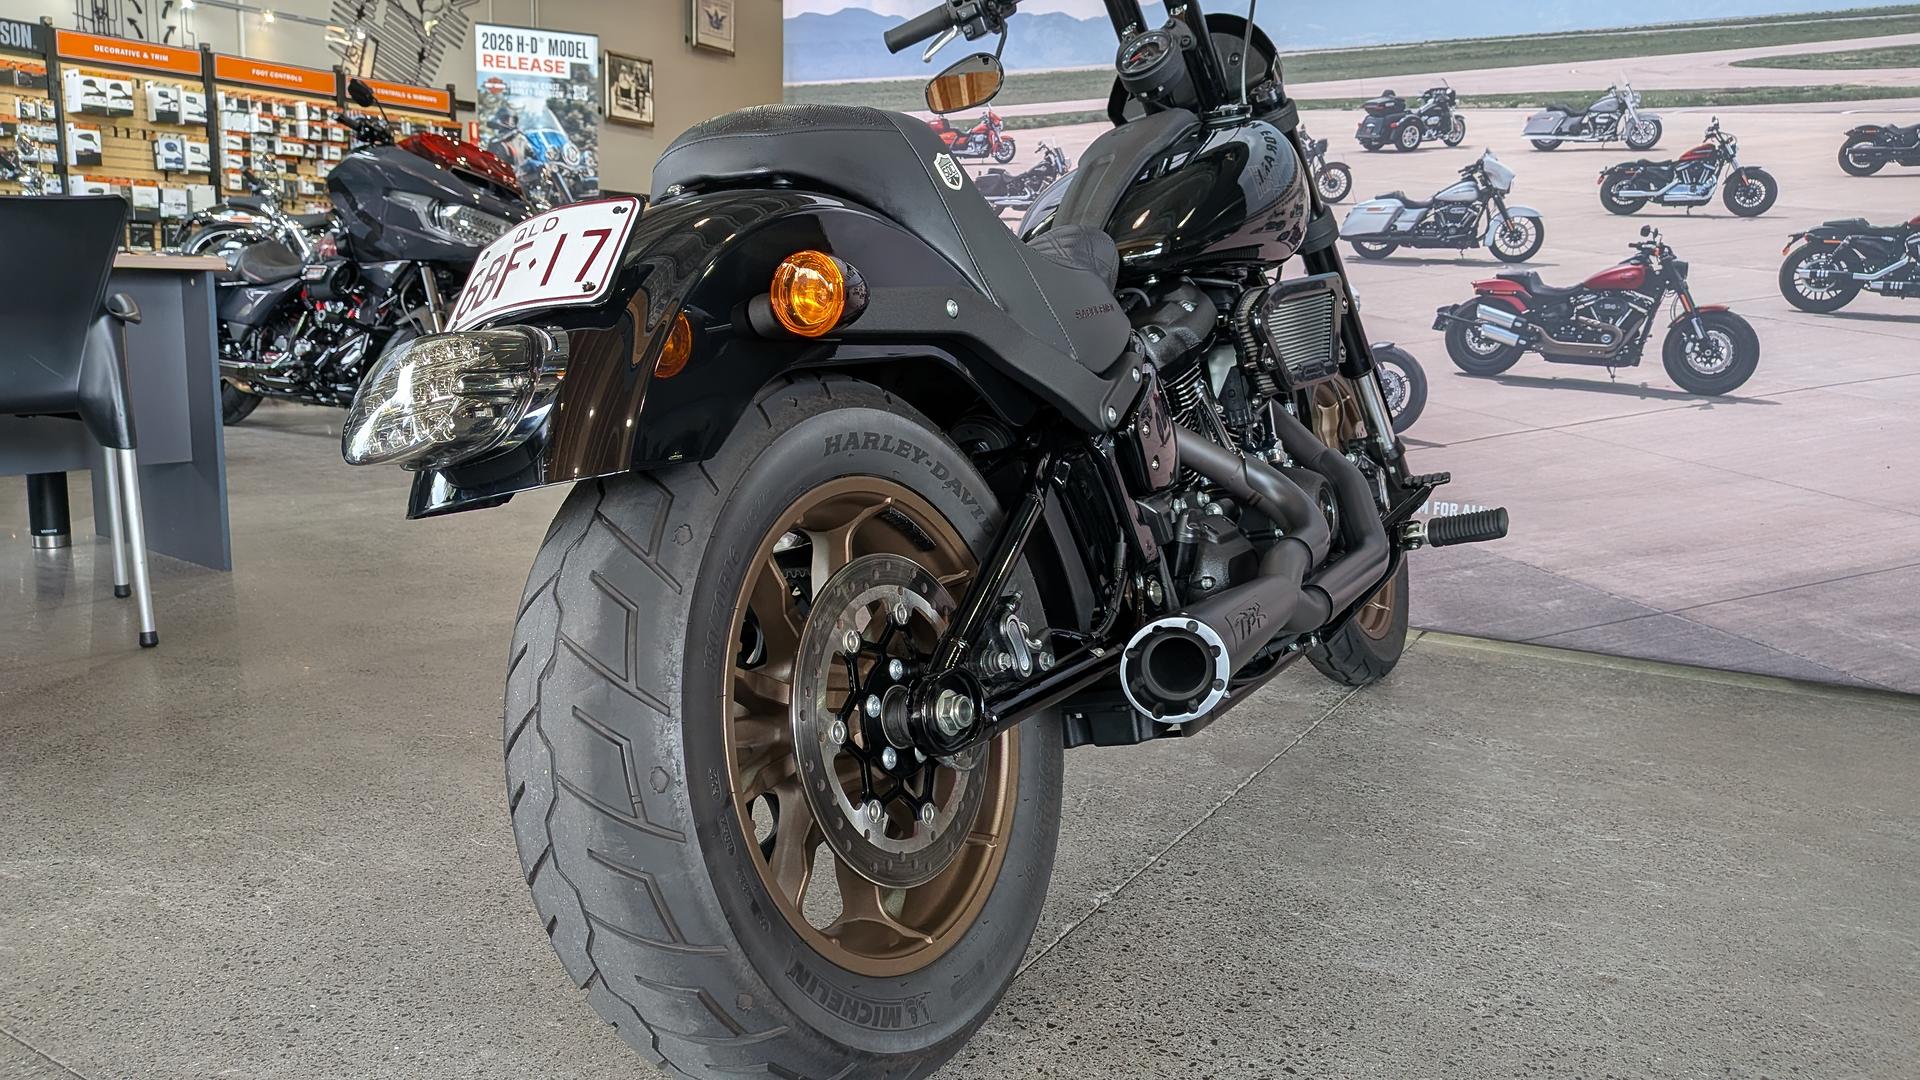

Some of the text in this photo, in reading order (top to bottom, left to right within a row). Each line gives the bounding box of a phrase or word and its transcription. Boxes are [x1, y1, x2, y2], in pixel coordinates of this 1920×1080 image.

[94, 44, 141, 58] DECORATIVE
[151, 52, 169, 62] TRIM
[482, 32, 513, 52] 2026
[548, 38, 589, 60] MODEL
[482, 53, 566, 74] RELEASE
[514, 216, 560, 244] QLD
[1433, 501, 1459, 517] FOR
[788, 960, 902, 1029] MICHELIN
